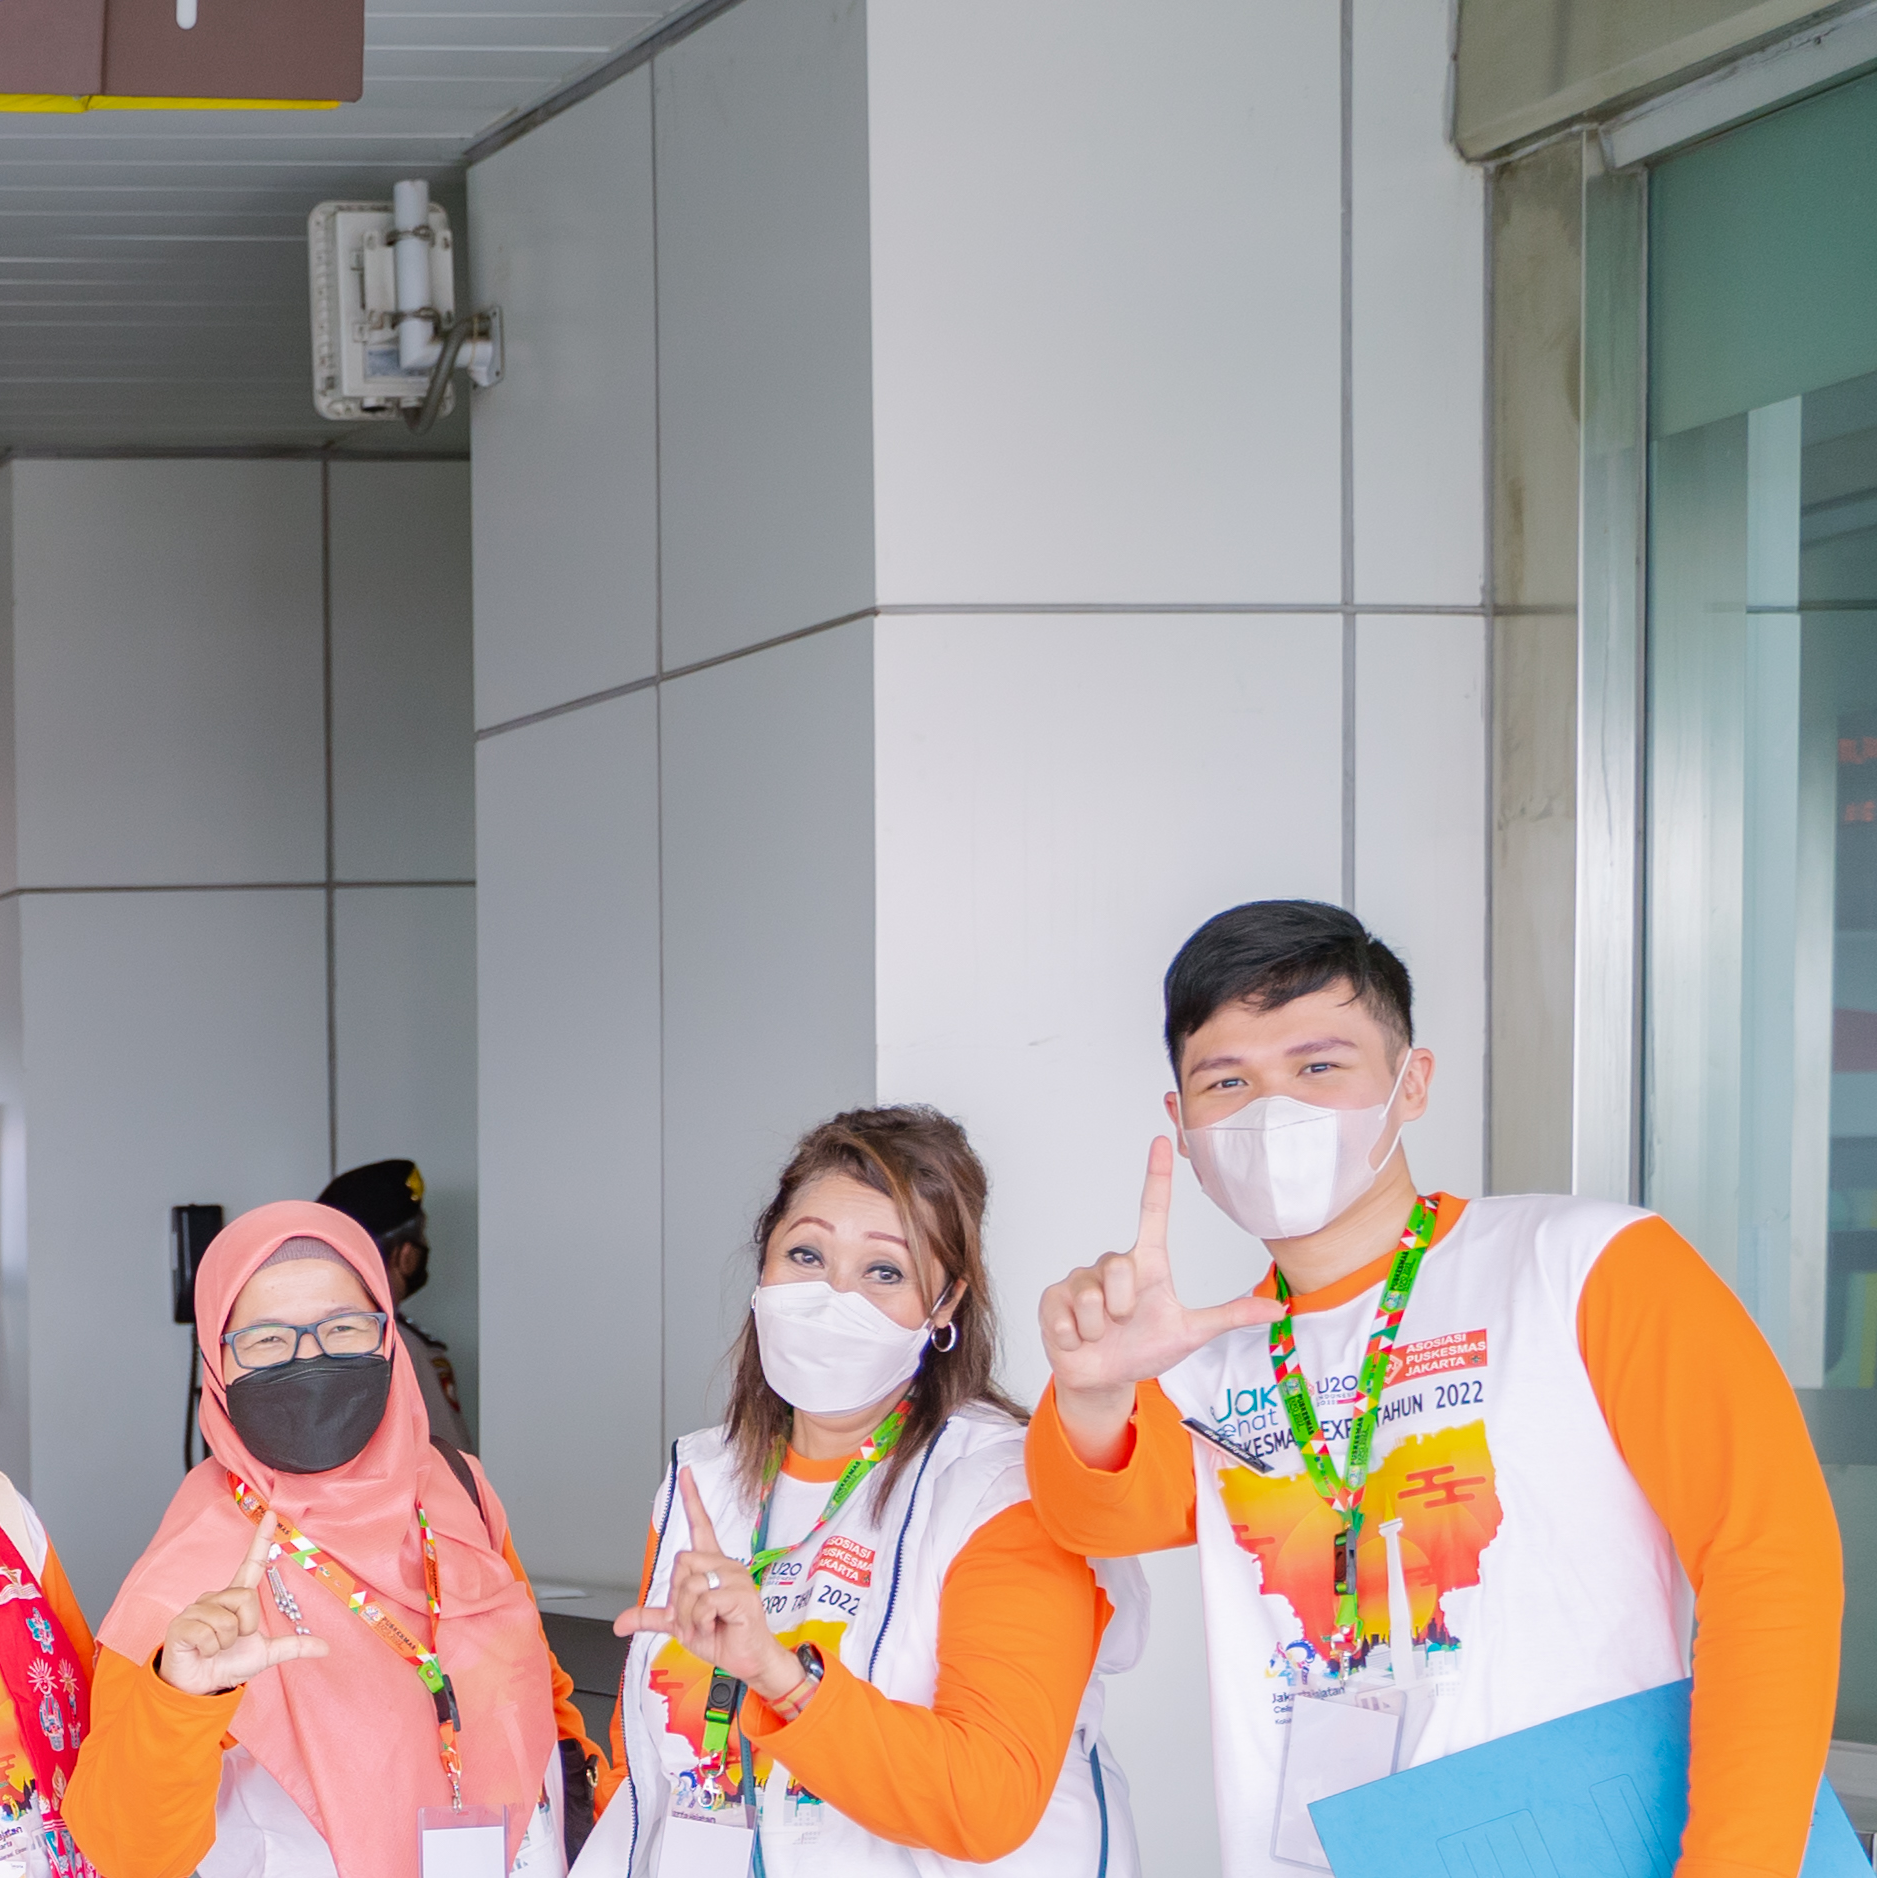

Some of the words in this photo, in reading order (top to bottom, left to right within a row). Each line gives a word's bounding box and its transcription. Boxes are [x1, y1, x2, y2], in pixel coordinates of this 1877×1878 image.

[1406, 1333, 1467, 1354] ASOSIASI
[1406, 1341, 1486, 1364] PUSKESMAS
[1405, 1356, 1465, 1376] JAKARTA
[1316, 1375, 1358, 1394] U20
[1211, 1384, 1278, 1423] Jak
[1217, 1409, 1278, 1437] ehat
[1243, 1428, 1298, 1458] KESMA
[1320, 1418, 1353, 1441] EXP
[1435, 1380, 1484, 1410] 2022
[771, 1562, 803, 1576] U20
[822, 1547, 873, 1572] USKESMA
[762, 1595, 788, 1614] XPO
[817, 1584, 861, 1616] 2022
